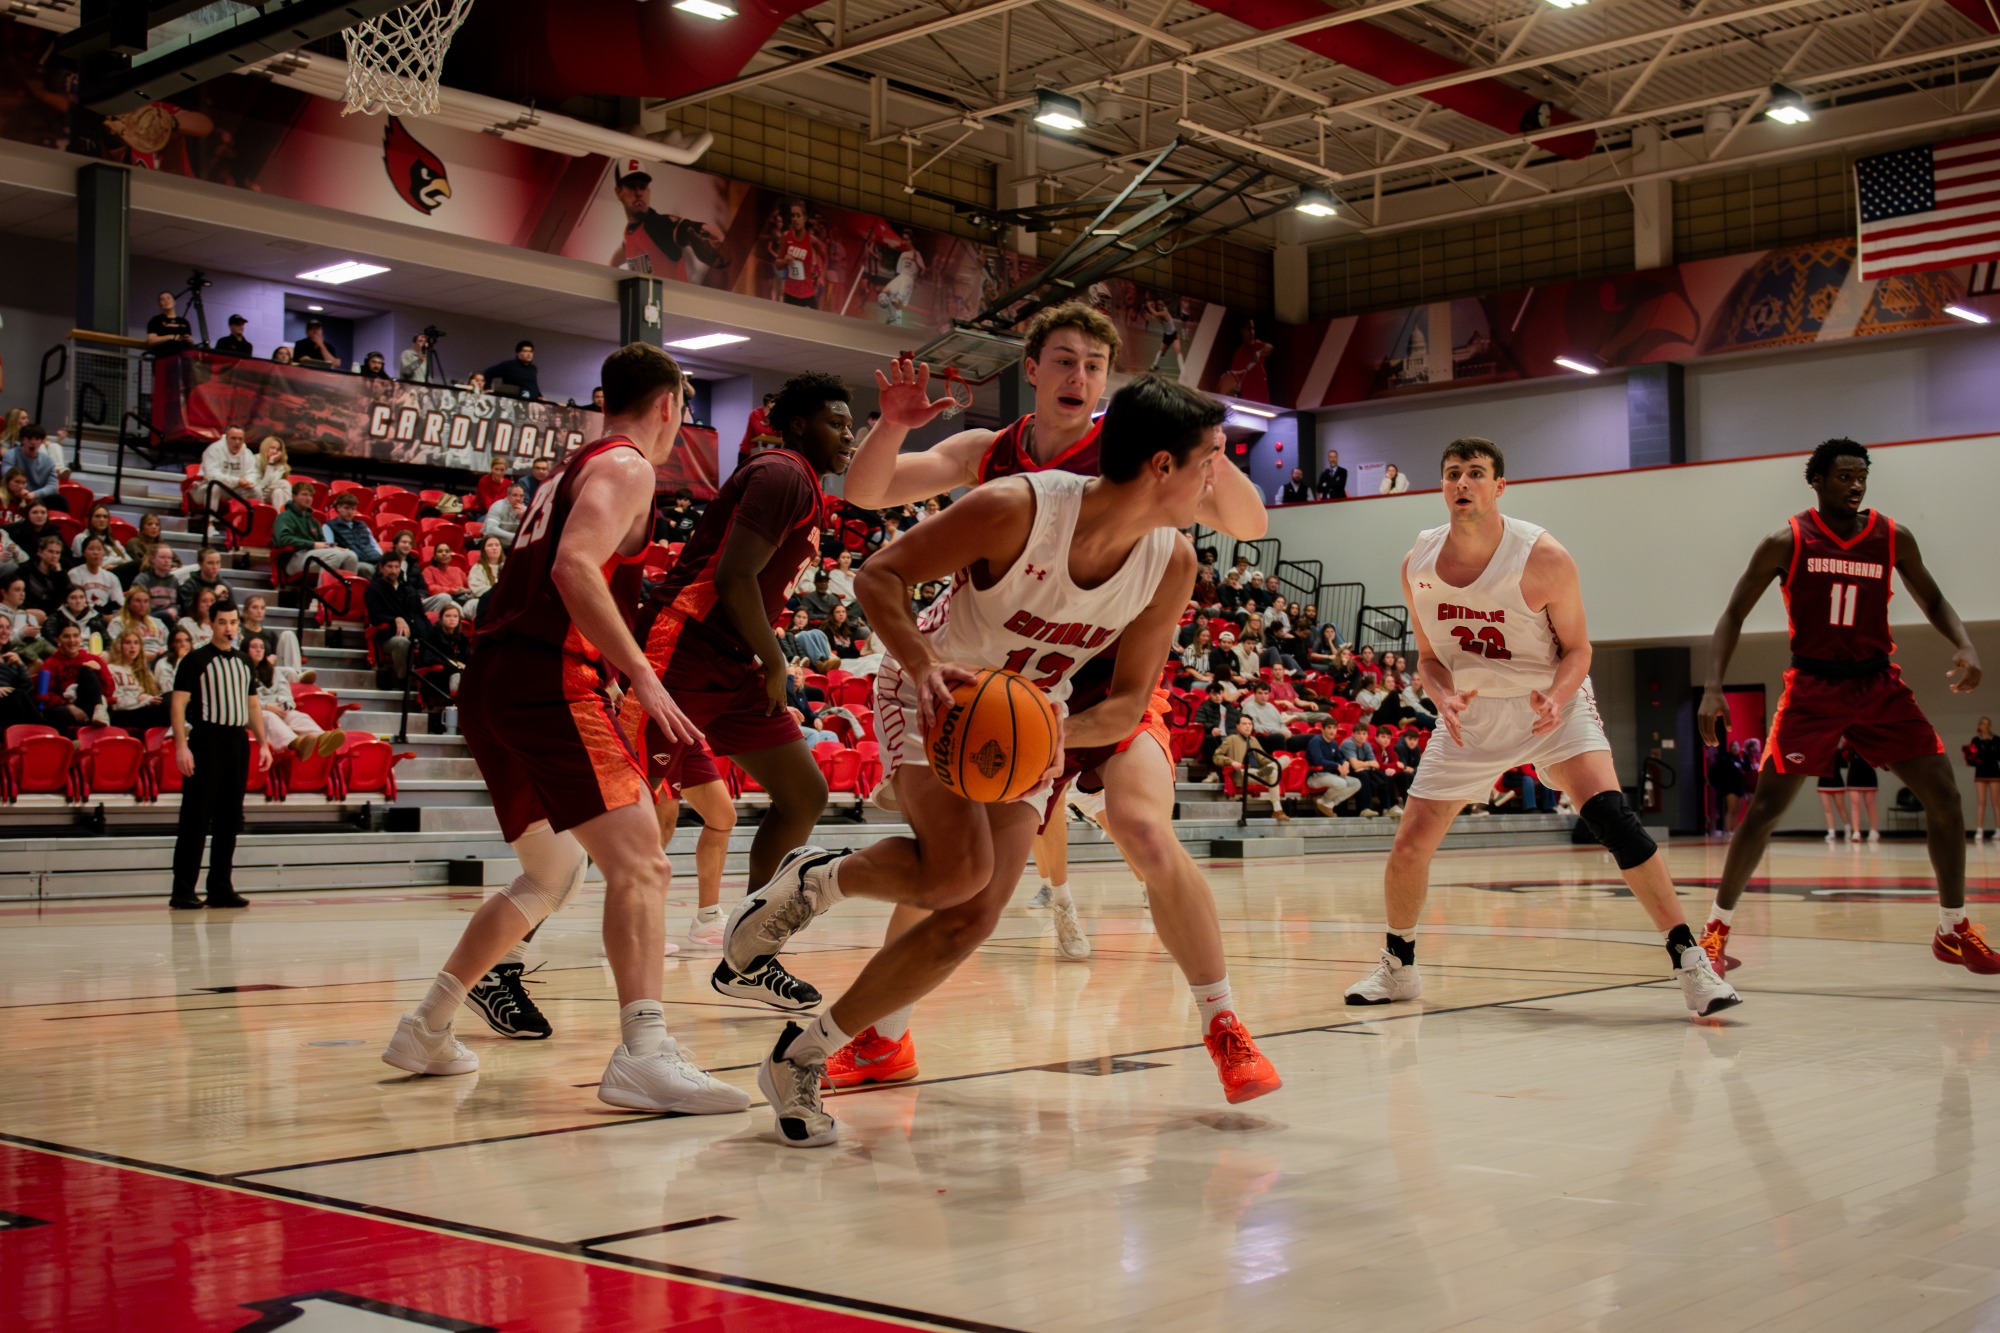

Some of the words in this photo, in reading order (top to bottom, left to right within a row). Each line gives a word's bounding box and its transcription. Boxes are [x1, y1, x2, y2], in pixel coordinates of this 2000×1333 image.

[369, 404, 584, 460] CARDINALS
[513, 470, 566, 550] 23
[1806, 557, 1884, 579] SUSQUEHANNA
[1437, 602, 1506, 624] CATHOLIC
[1829, 582, 1859, 627] 11
[1003, 609, 1117, 650] CATHOLIC
[1450, 625, 1513, 661] 22
[931, 703, 965, 787] Wilson
